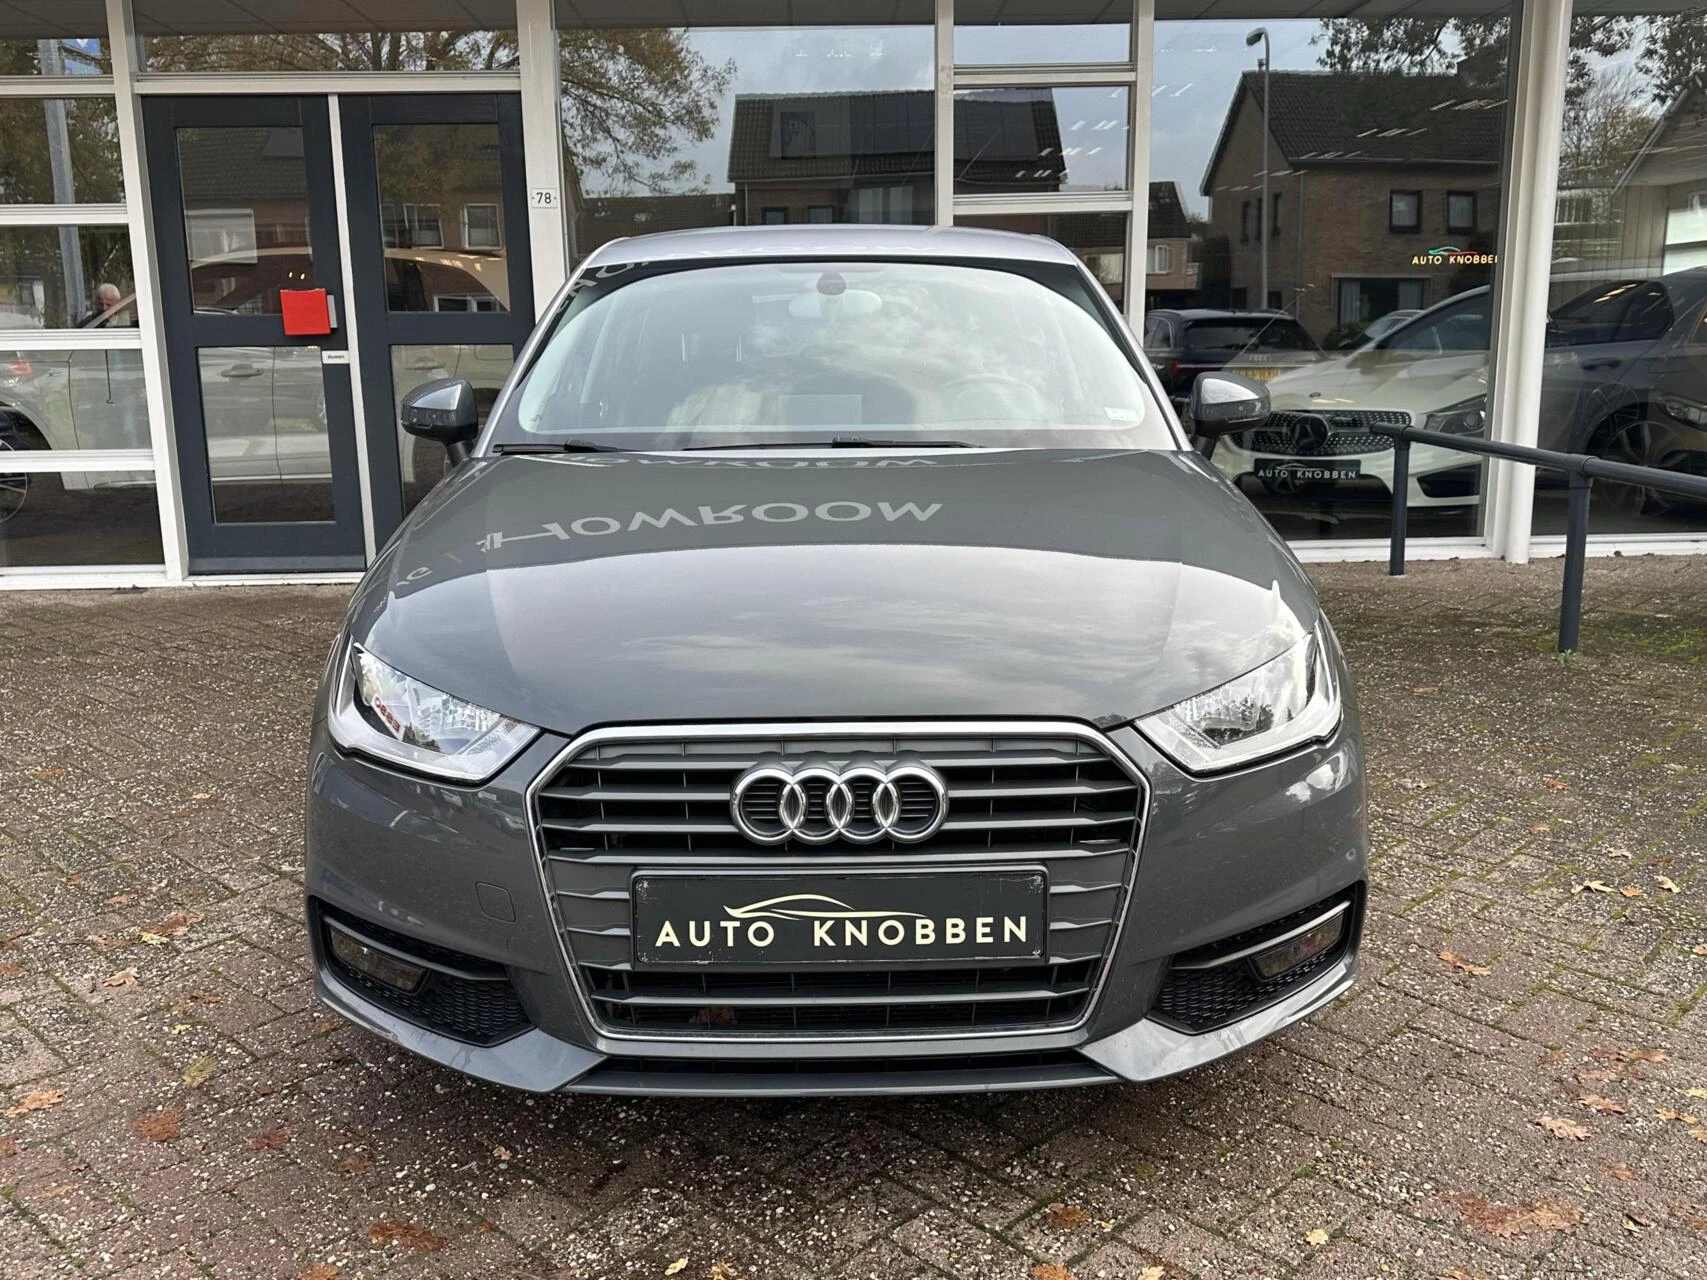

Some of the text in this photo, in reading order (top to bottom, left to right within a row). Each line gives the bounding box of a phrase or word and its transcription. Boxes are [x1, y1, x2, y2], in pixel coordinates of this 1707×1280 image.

[536, 192, 551, 204] 78
[1412, 256, 1442, 264] AUTO
[1258, 469, 1356, 479] AUTO KNOBBEN
[655, 916, 1028, 947] AUTO KNOBBEN
